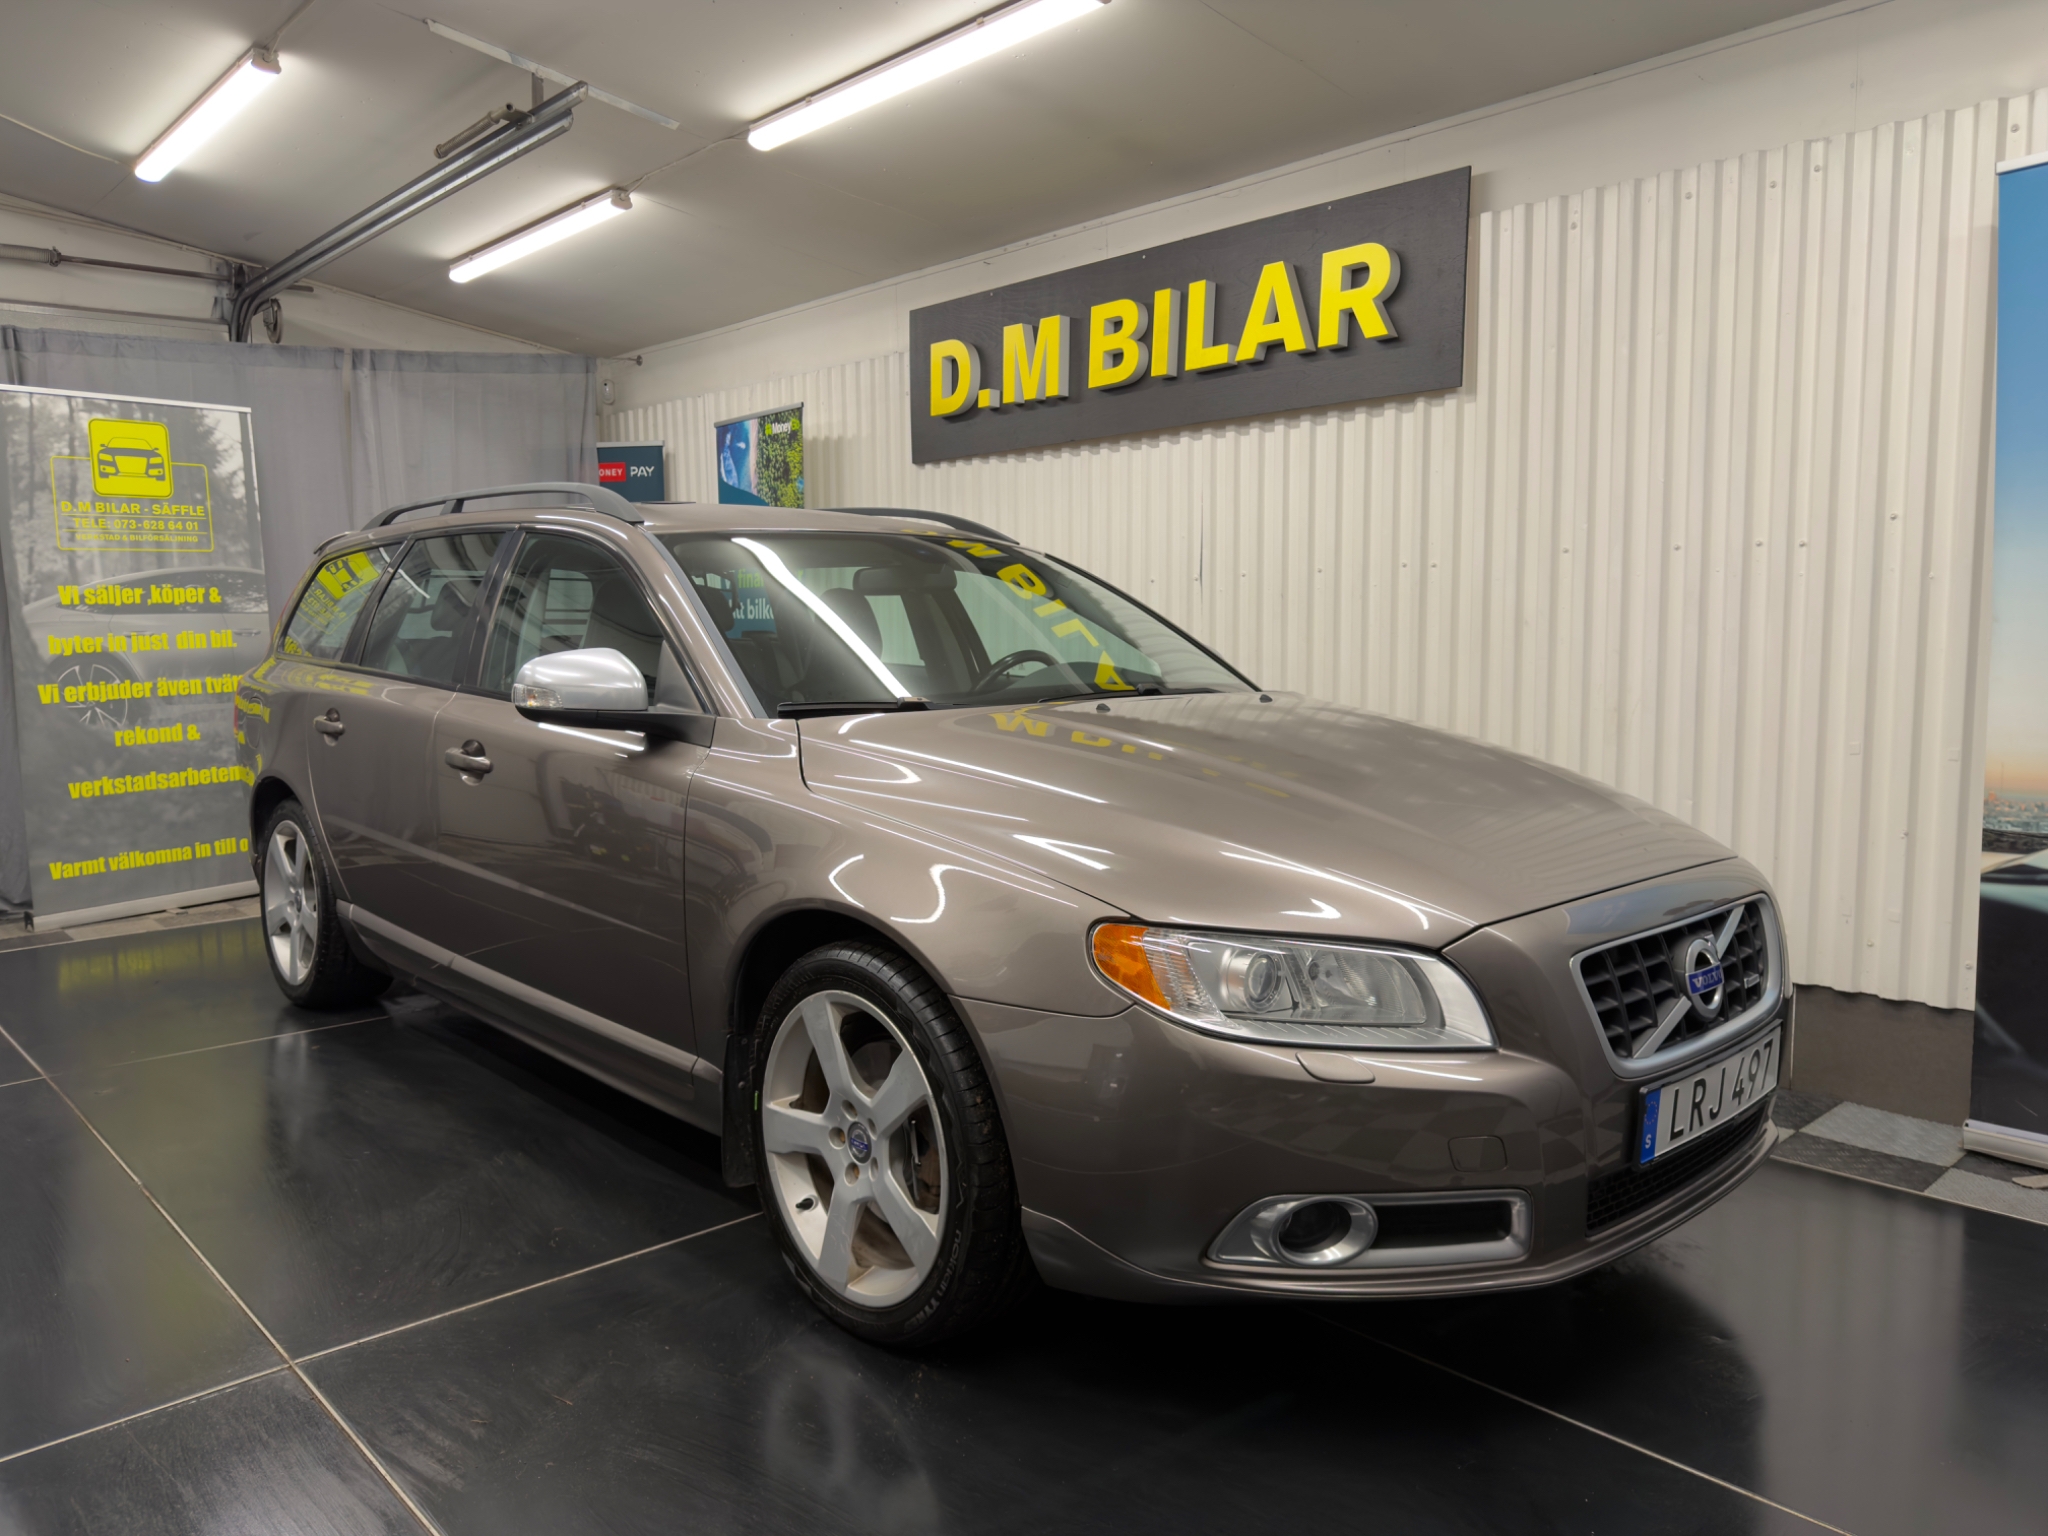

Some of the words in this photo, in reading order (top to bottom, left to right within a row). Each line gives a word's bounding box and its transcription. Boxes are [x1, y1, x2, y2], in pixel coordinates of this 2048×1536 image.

[930, 314, 1070, 417] D.M
[1088, 242, 1400, 390] BILAR
[598, 468, 623, 477] ONEY
[630, 466, 655, 477] PAY
[61, 501, 91, 513] D.M
[95, 502, 140, 514] BILAR
[152, 503, 205, 516] SÄFFLE
[73, 518, 111, 529] TELE:
[113, 520, 165, 530] 073-628
[168, 521, 183, 531] 64
[186, 522, 199, 531] 01
[738, 568, 764, 589] fina
[57, 585, 80, 605] Vi
[84, 584, 143, 606] säljer
[208, 587, 222, 603] &
[47, 633, 104, 656] byter
[108, 633, 127, 652] in
[131, 632, 170, 654] just
[176, 630, 207, 649] din
[210, 630, 238, 649] bil.
[37, 684, 60, 704] Vi
[64, 680, 153, 705] erbjuder
[157, 677, 202, 697] även
[205, 674, 244, 694] tvät
[114, 722, 183, 747] rekond
[186, 724, 201, 741] &
[68, 765, 241, 799] verkstadsarbeten
[49, 856, 107, 880] Varmt
[108, 845, 193, 872] välkomna
[195, 841, 212, 859] in
[213, 837, 237, 856] till
[1645, 1134, 1652, 1149] S
[1670, 1067, 1726, 1141] LRJ
[1732, 1038, 1773, 1107] 497
